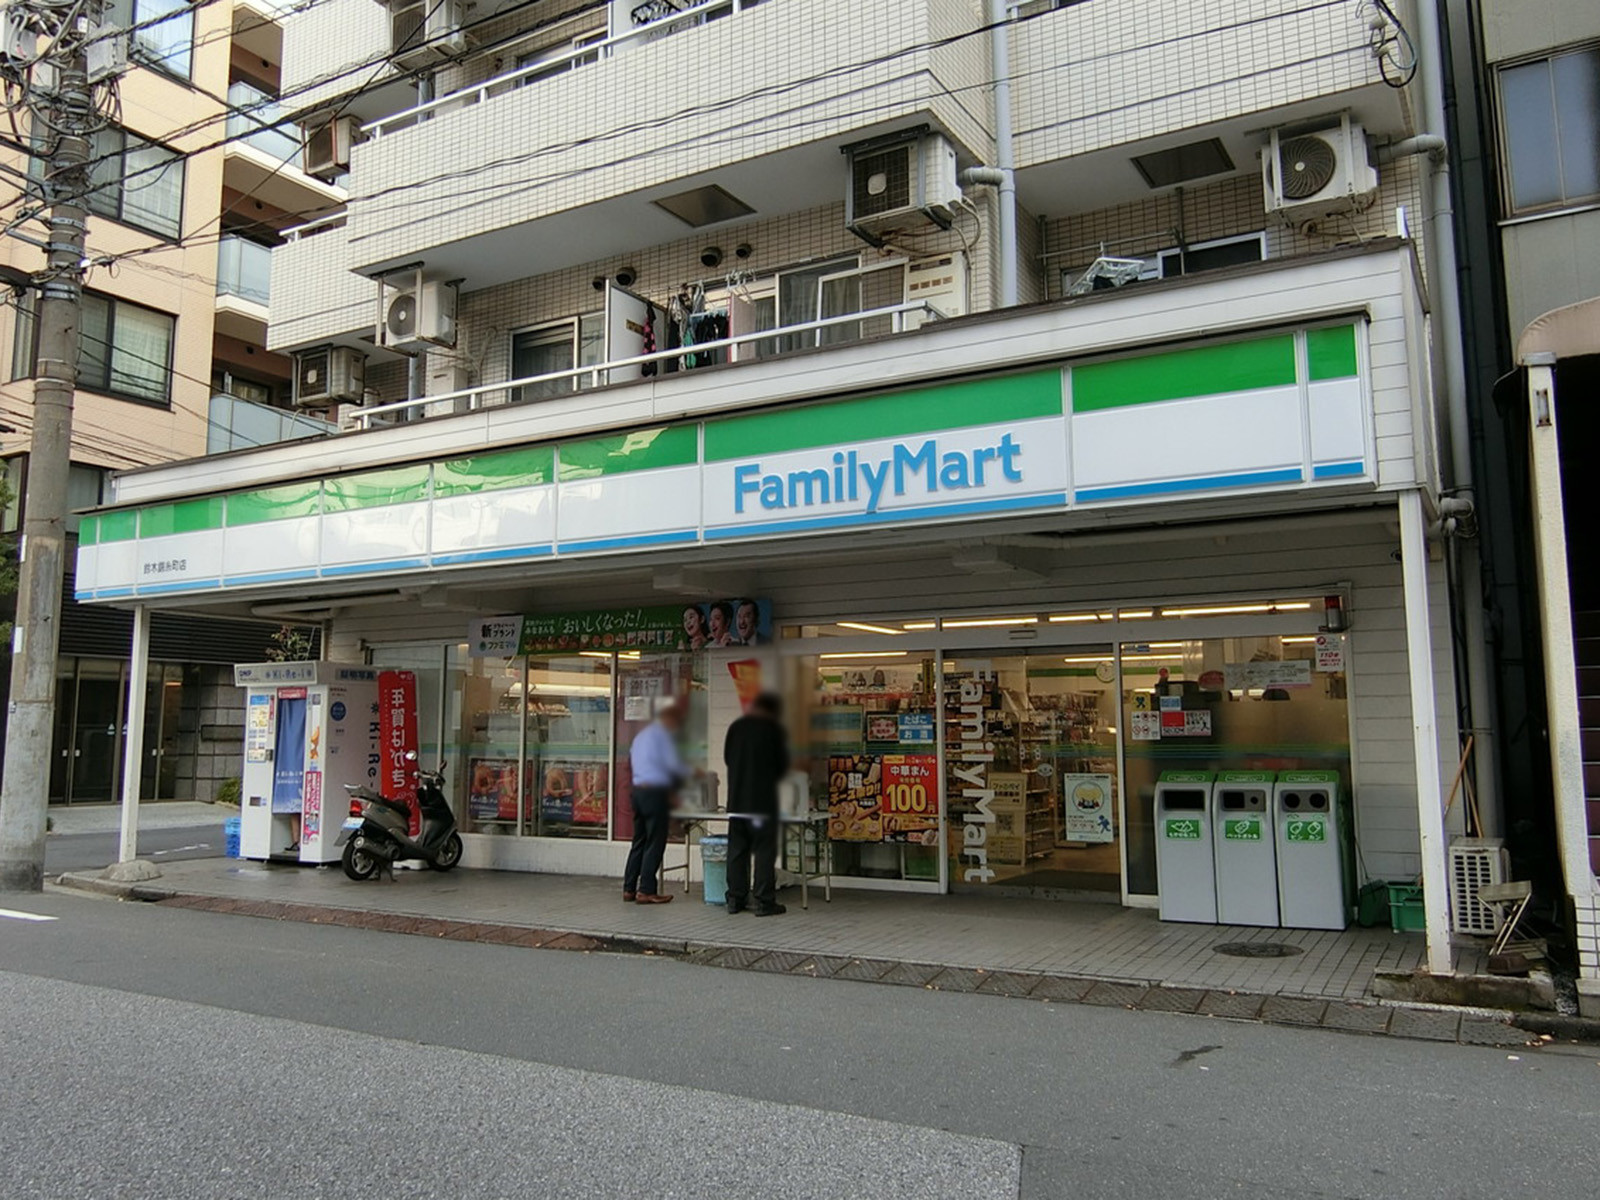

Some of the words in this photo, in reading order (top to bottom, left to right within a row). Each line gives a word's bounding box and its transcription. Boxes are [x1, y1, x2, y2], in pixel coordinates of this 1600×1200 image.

[735, 432, 1022, 514] FamilyMart
[143, 559, 187, 575] 鈴木錦糸町店
[904, 715, 928, 724] たばこ
[890, 765, 930, 776] 中華まん
[953, 659, 997, 883] FamilyMart
[886, 783, 926, 812] 100
